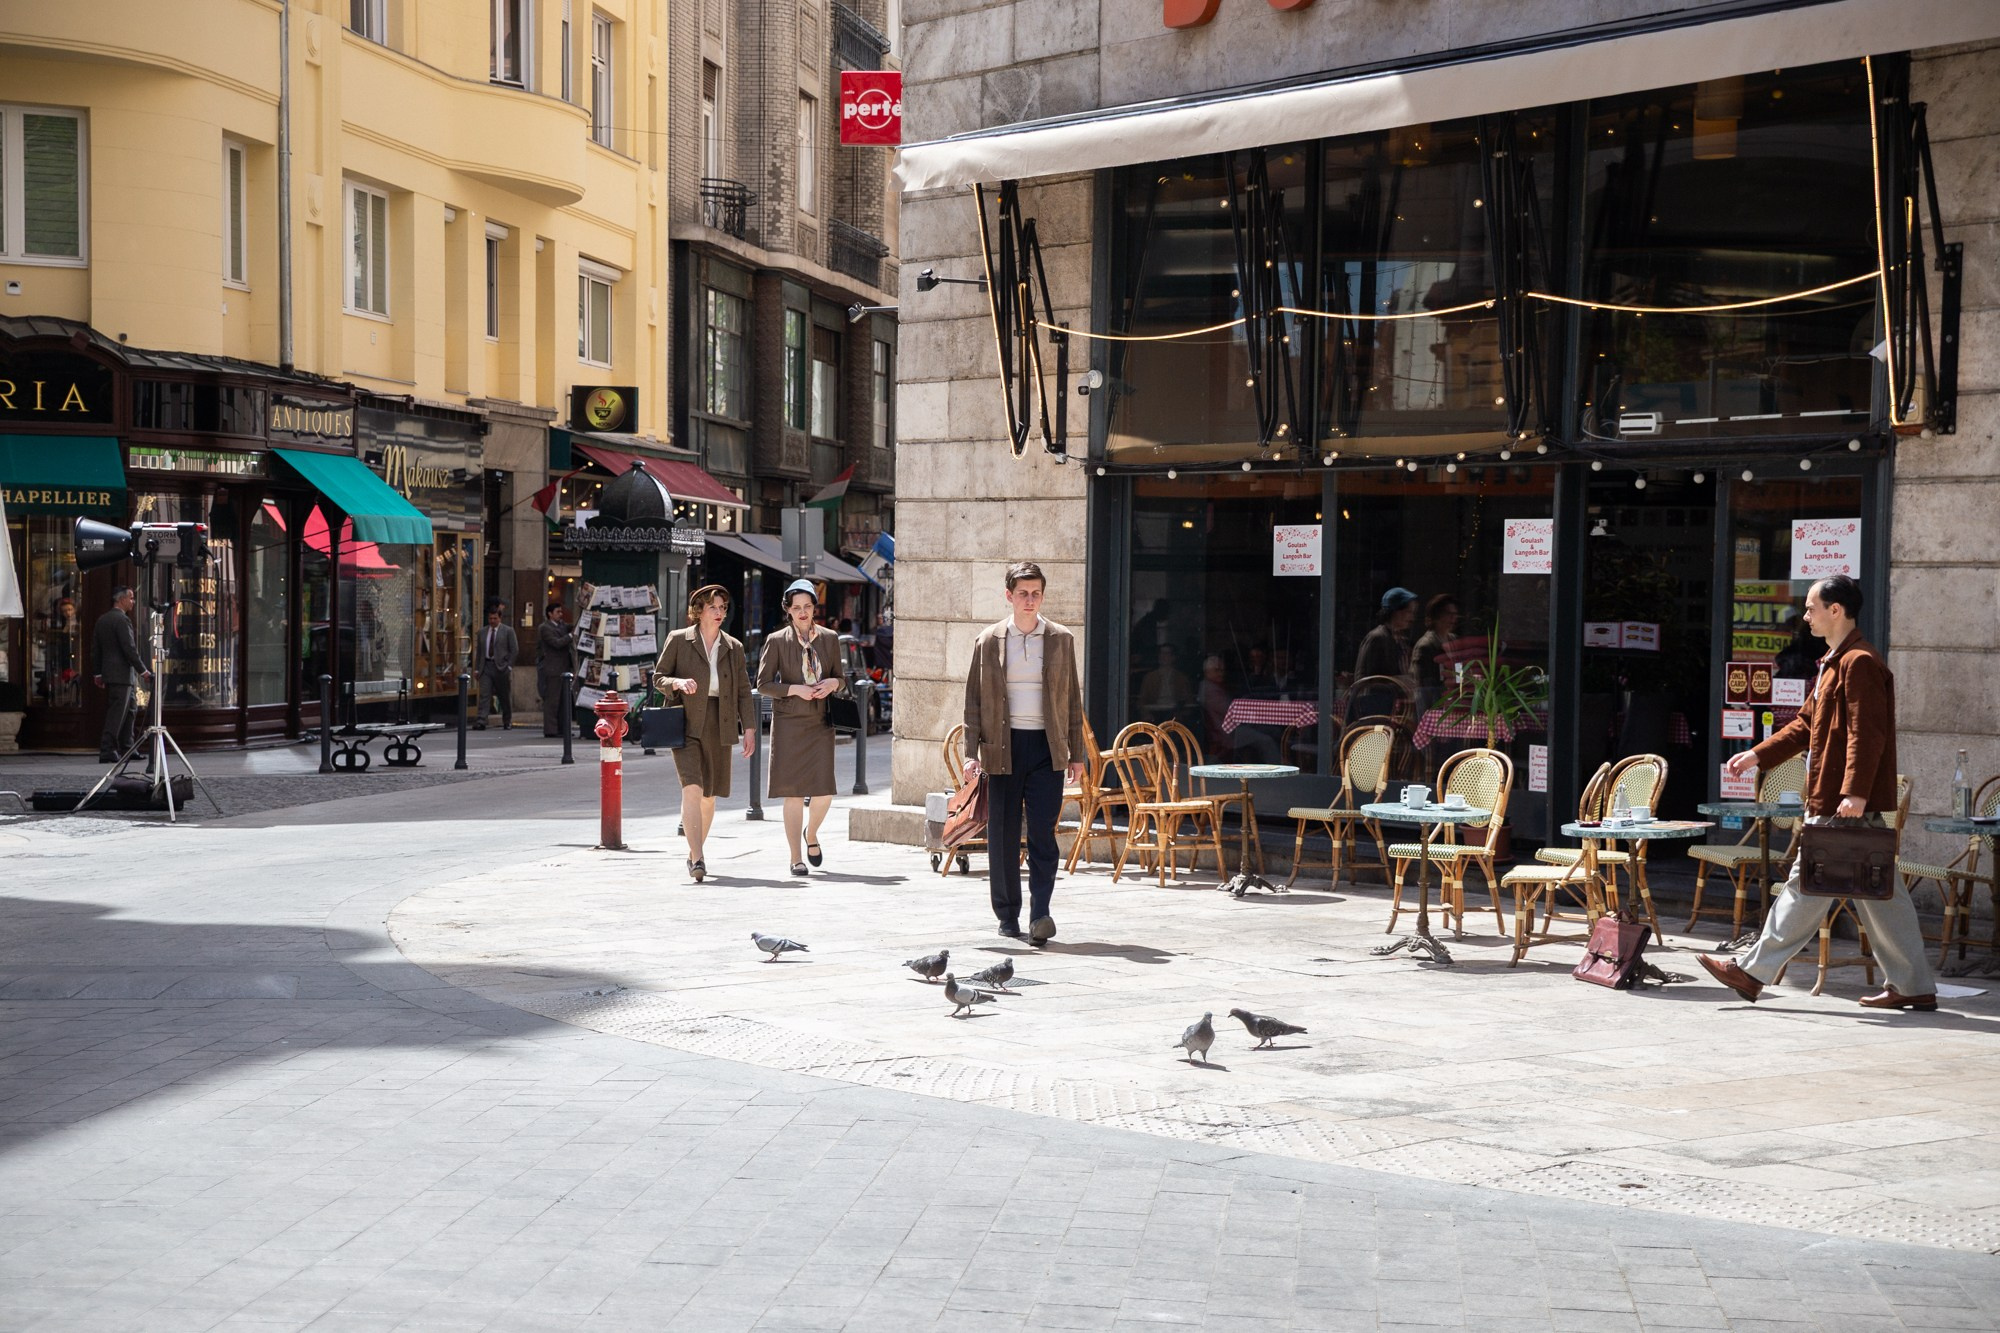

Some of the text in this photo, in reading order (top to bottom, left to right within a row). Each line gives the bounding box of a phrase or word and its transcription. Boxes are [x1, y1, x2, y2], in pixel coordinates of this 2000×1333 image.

[272, 405, 351, 439] ANTIQUES
[384, 444, 449, 500] Makausz
[146, 531, 177, 539] STORM
[1515, 549, 1538, 557] Langosh
[1804, 552, 1833, 561] Langosh
